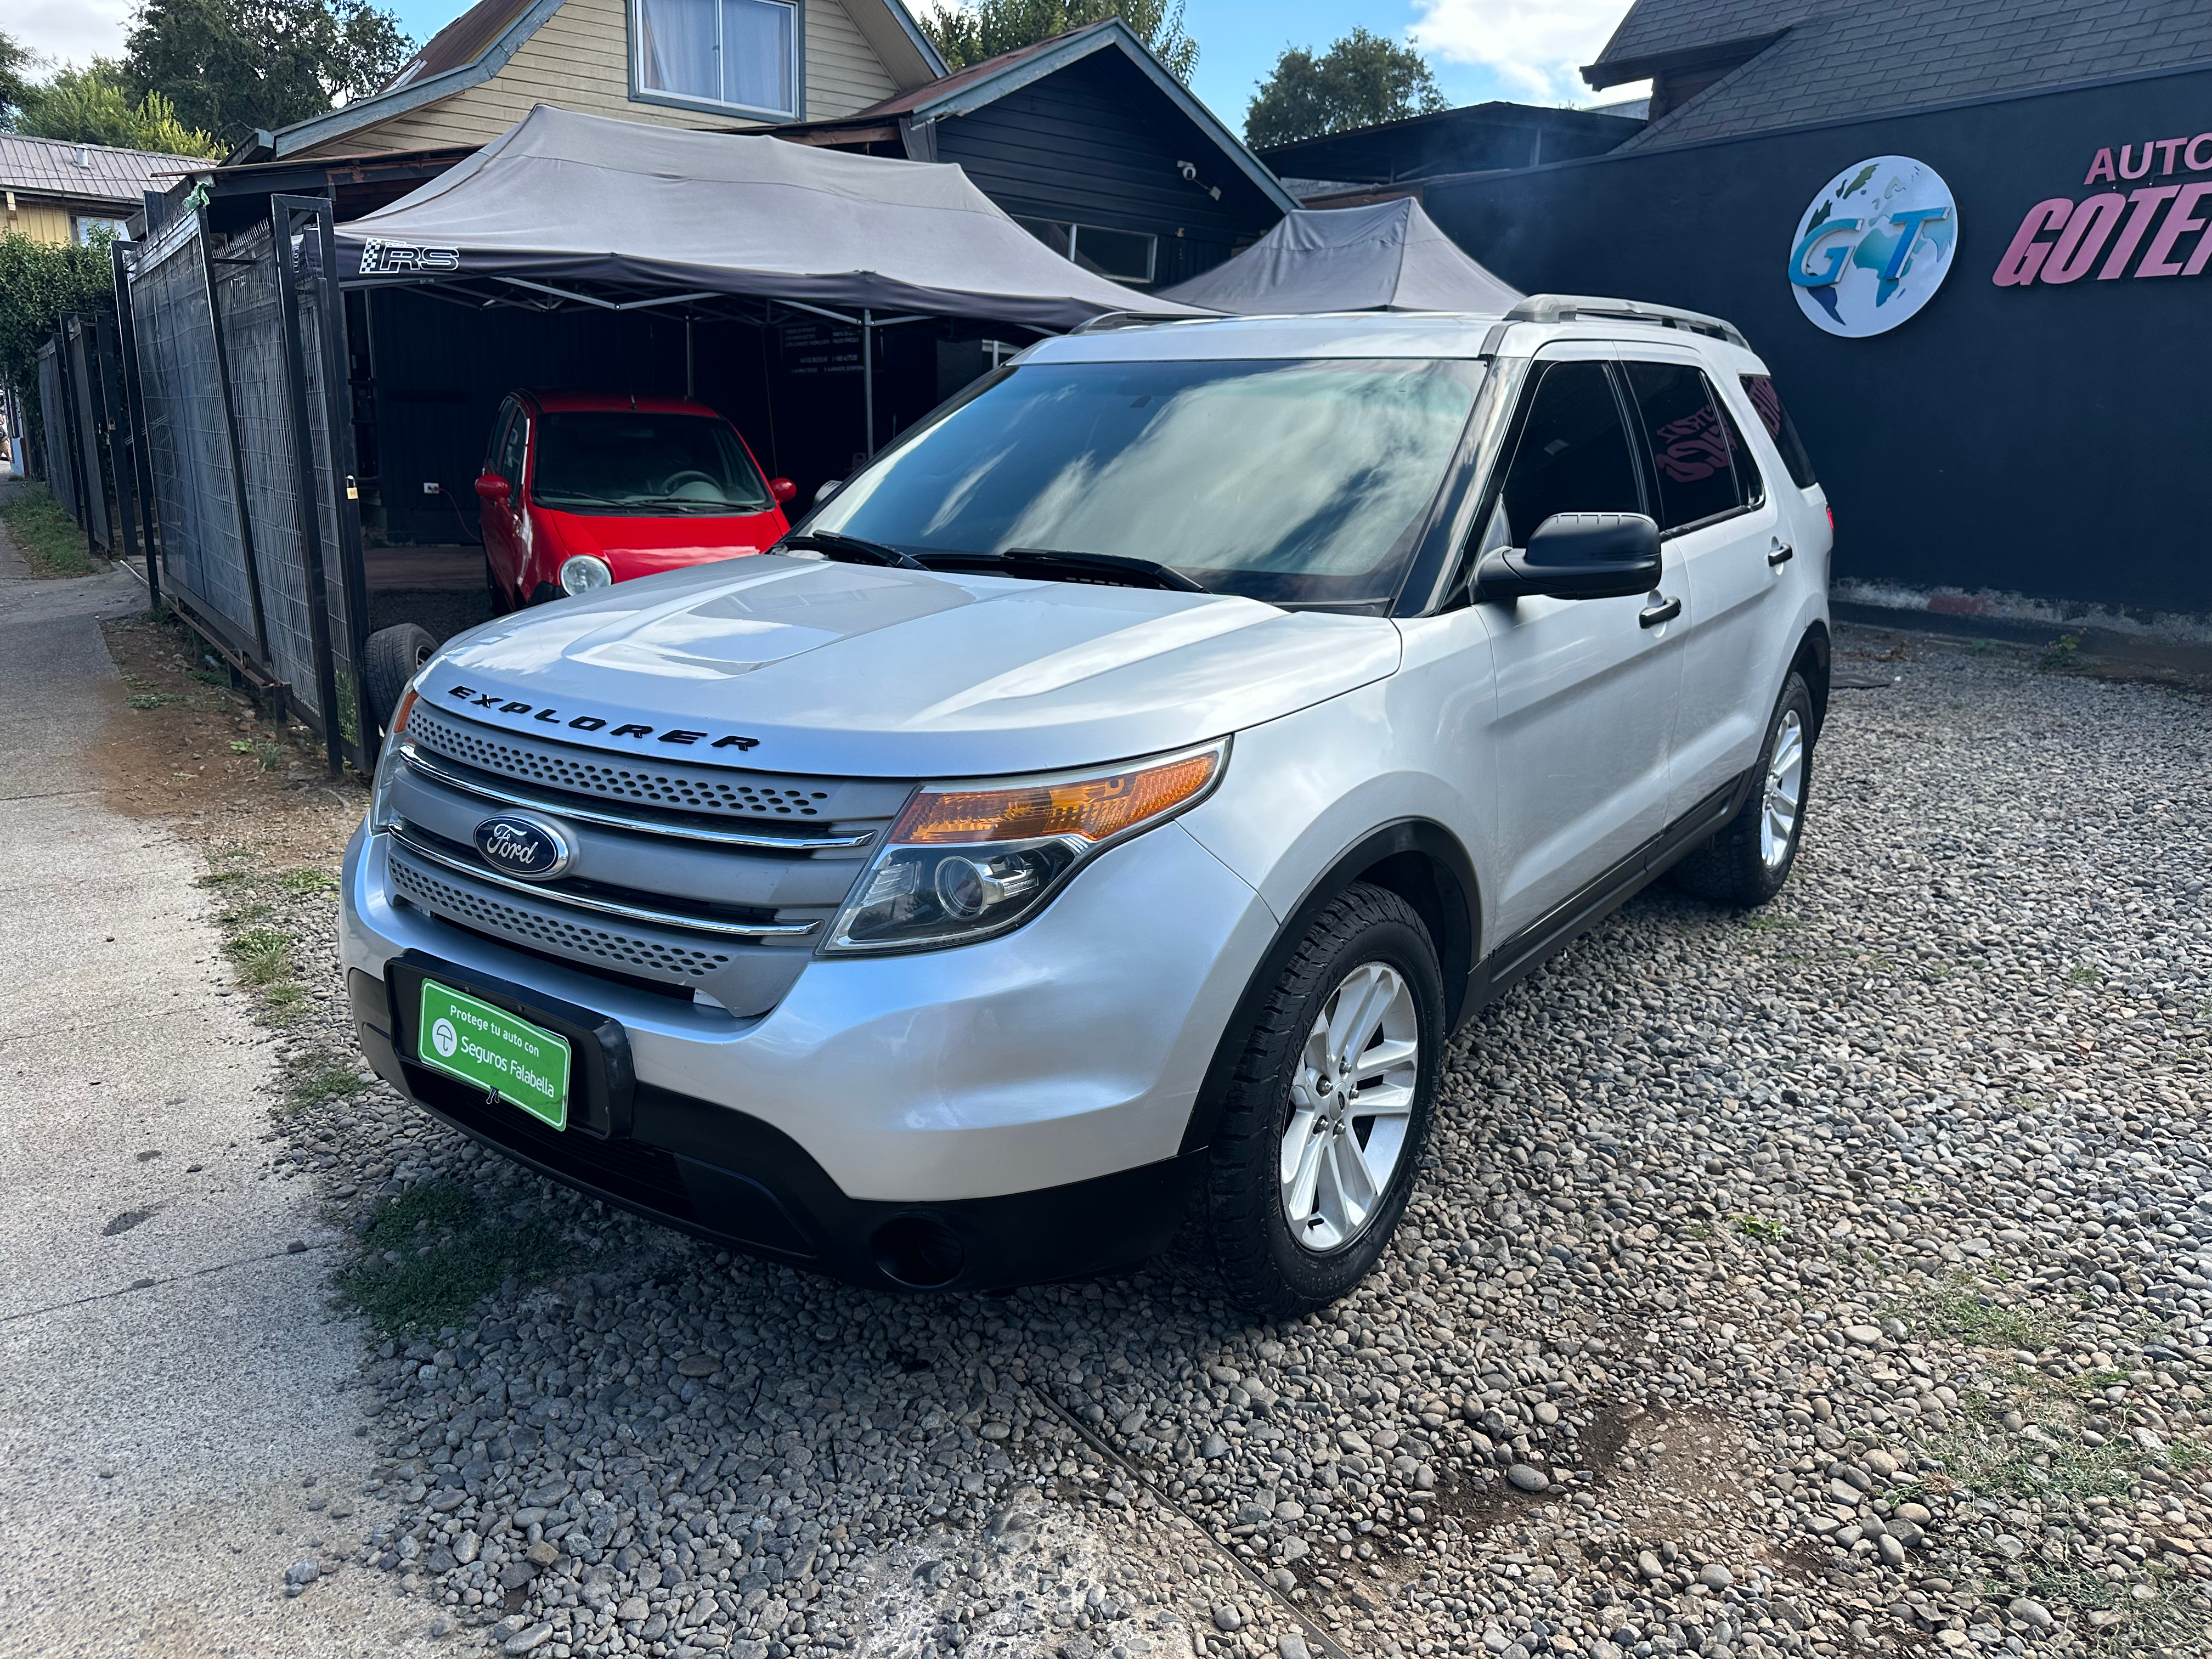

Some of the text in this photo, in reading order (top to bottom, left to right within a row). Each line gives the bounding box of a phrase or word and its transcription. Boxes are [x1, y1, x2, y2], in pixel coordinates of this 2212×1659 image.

[448, 685, 761, 752] EXPLORER
[486, 823, 539, 864] Ford
[449, 1005, 539, 1058] Protege tu auto con
[460, 1036, 555, 1098] Seguros Falabella
